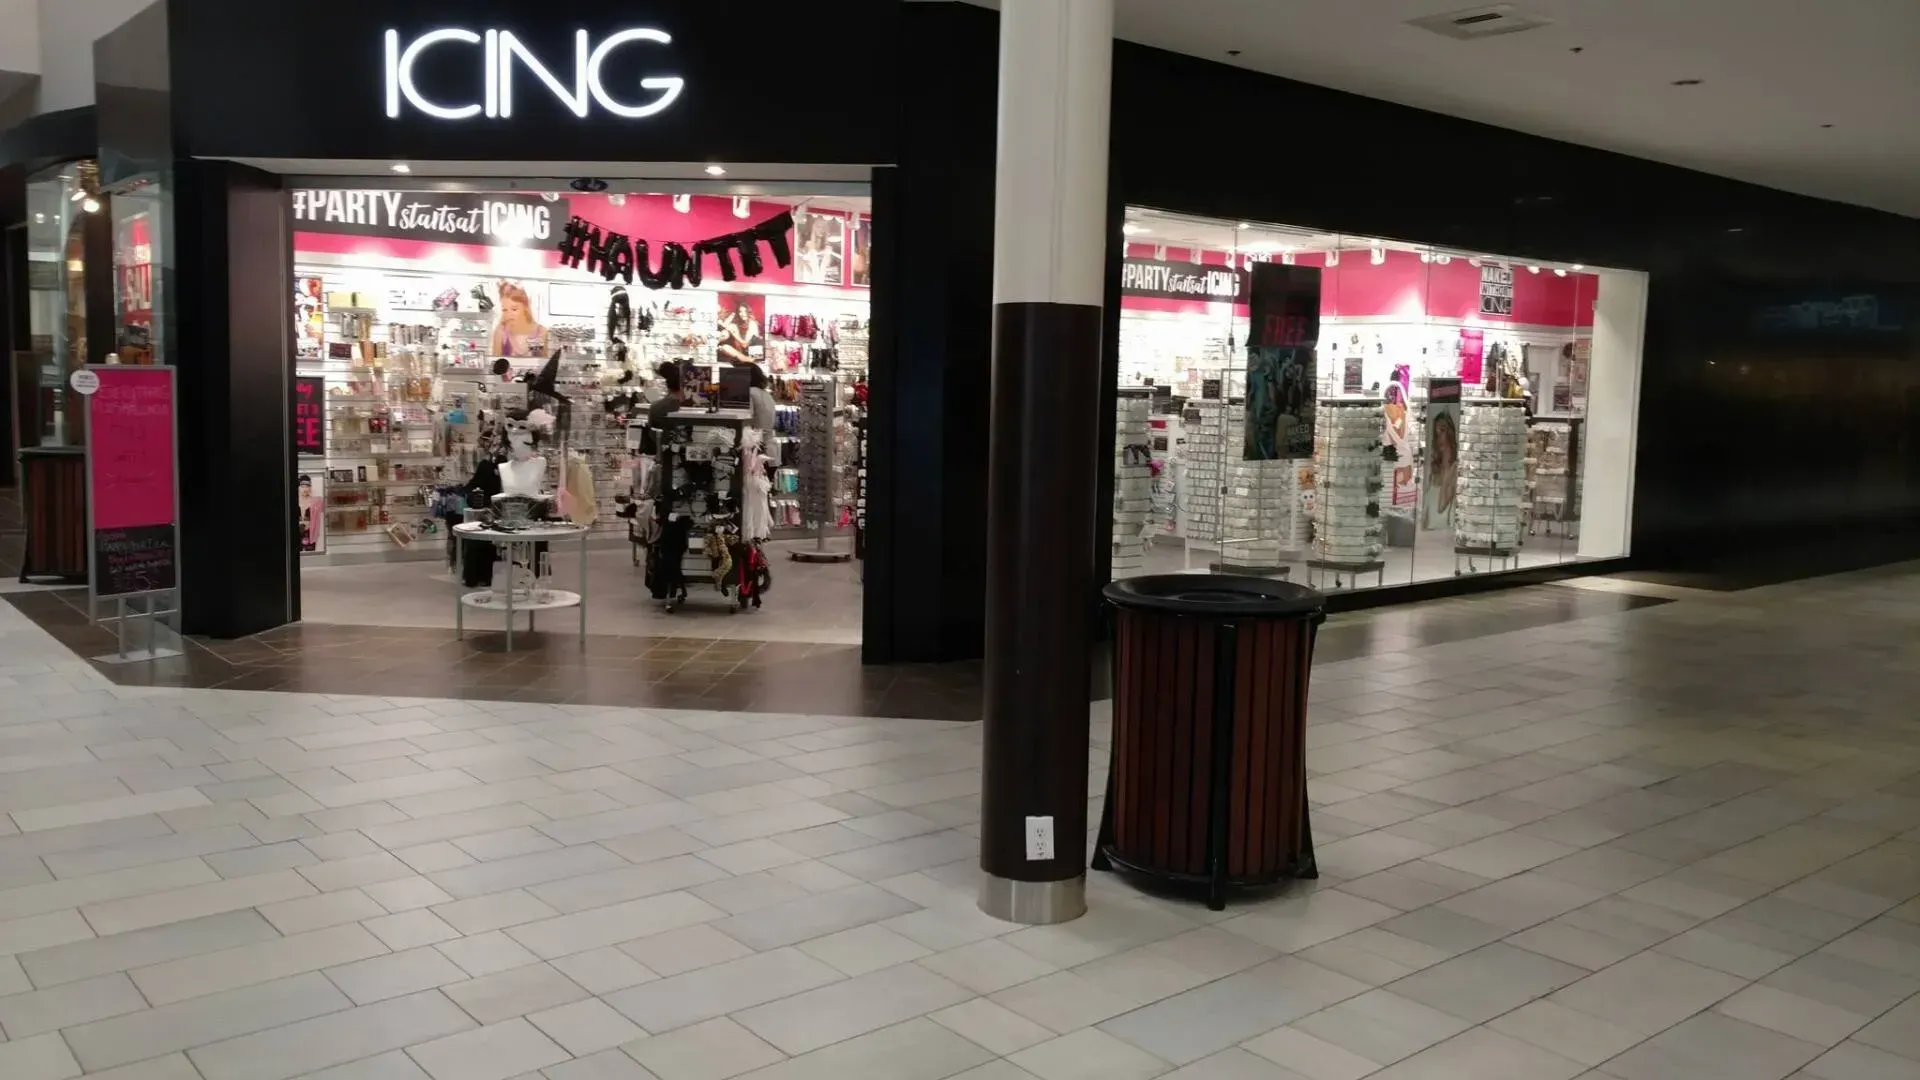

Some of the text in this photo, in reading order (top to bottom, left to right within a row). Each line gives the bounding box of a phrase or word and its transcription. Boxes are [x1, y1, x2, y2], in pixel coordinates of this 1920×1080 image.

[385, 28, 684, 118] ICING
[481, 200, 550, 240] ICING
[1207, 270, 1240, 297] ICING
[1262, 313, 1309, 346] FREE
